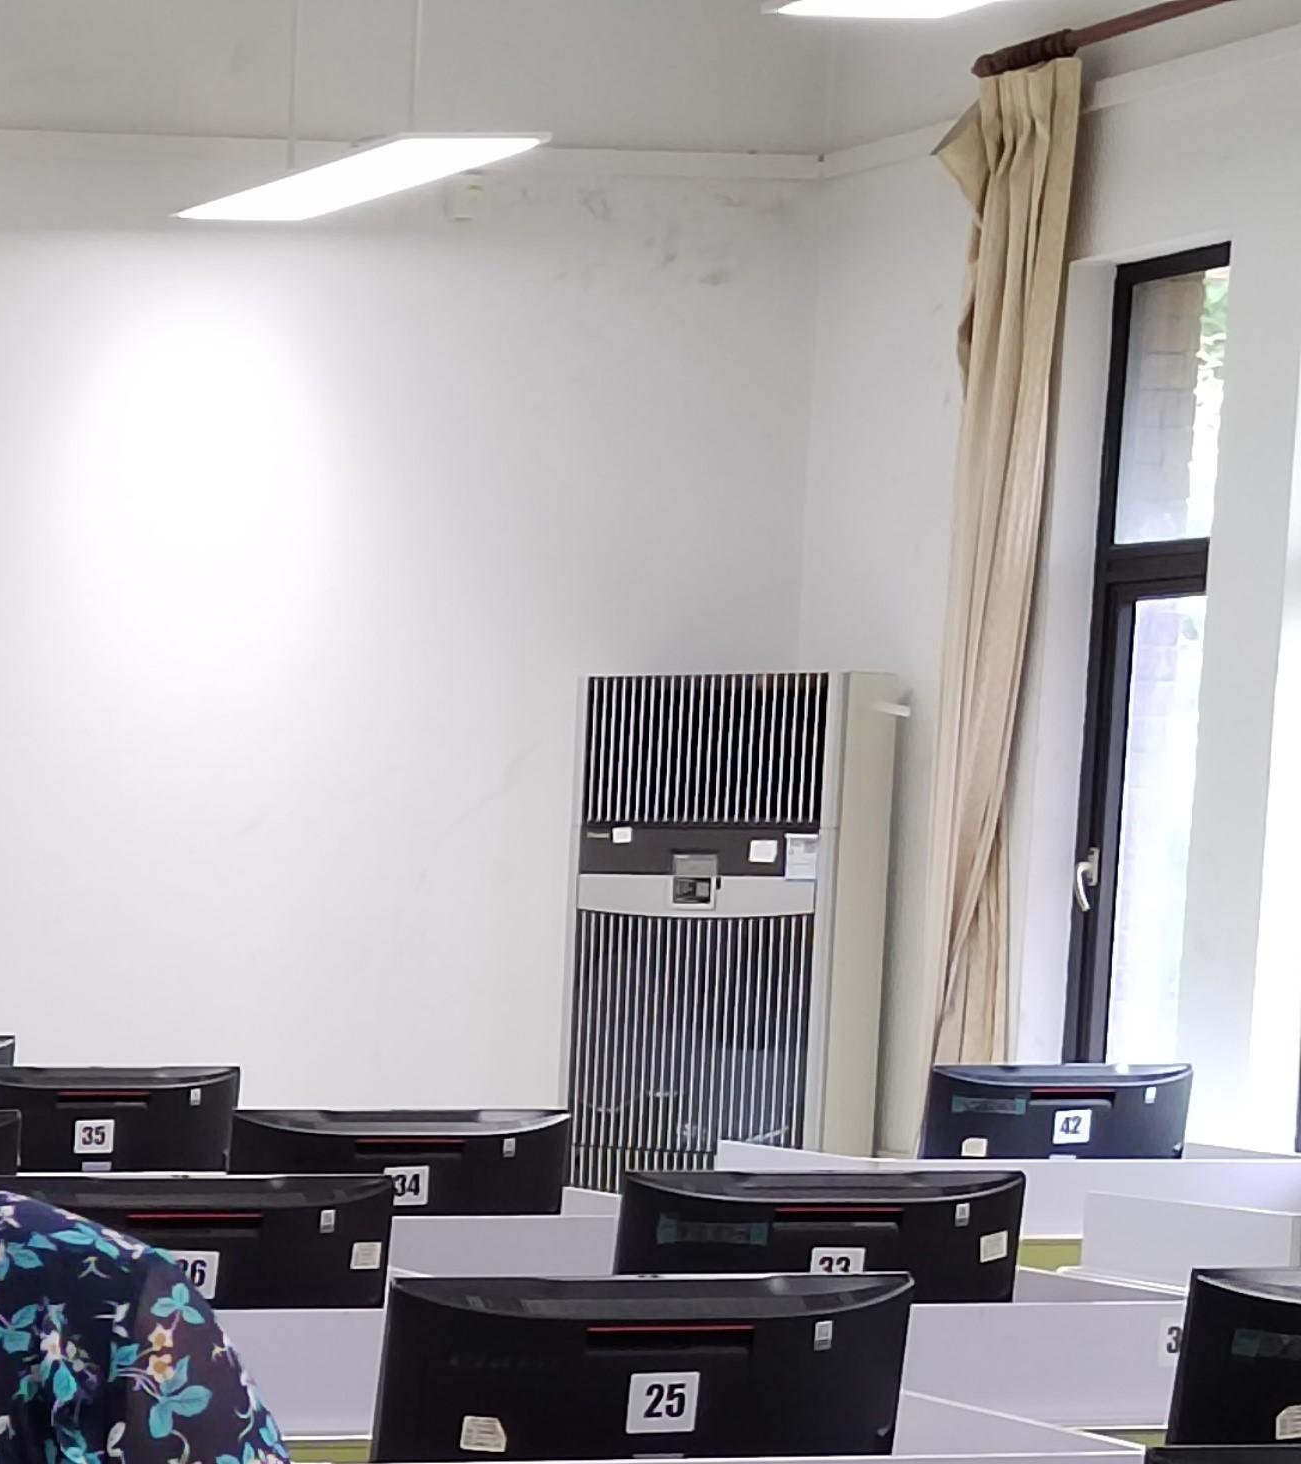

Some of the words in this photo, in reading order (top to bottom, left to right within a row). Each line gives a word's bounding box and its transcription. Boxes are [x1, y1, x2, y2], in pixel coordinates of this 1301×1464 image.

[82, 1126, 105, 1145] 35
[1060, 1116, 1081, 1134] 42
[394, 1174, 420, 1196] 34
[1166, 1326, 1181, 1353] 3
[644, 1384, 686, 1418] 25
